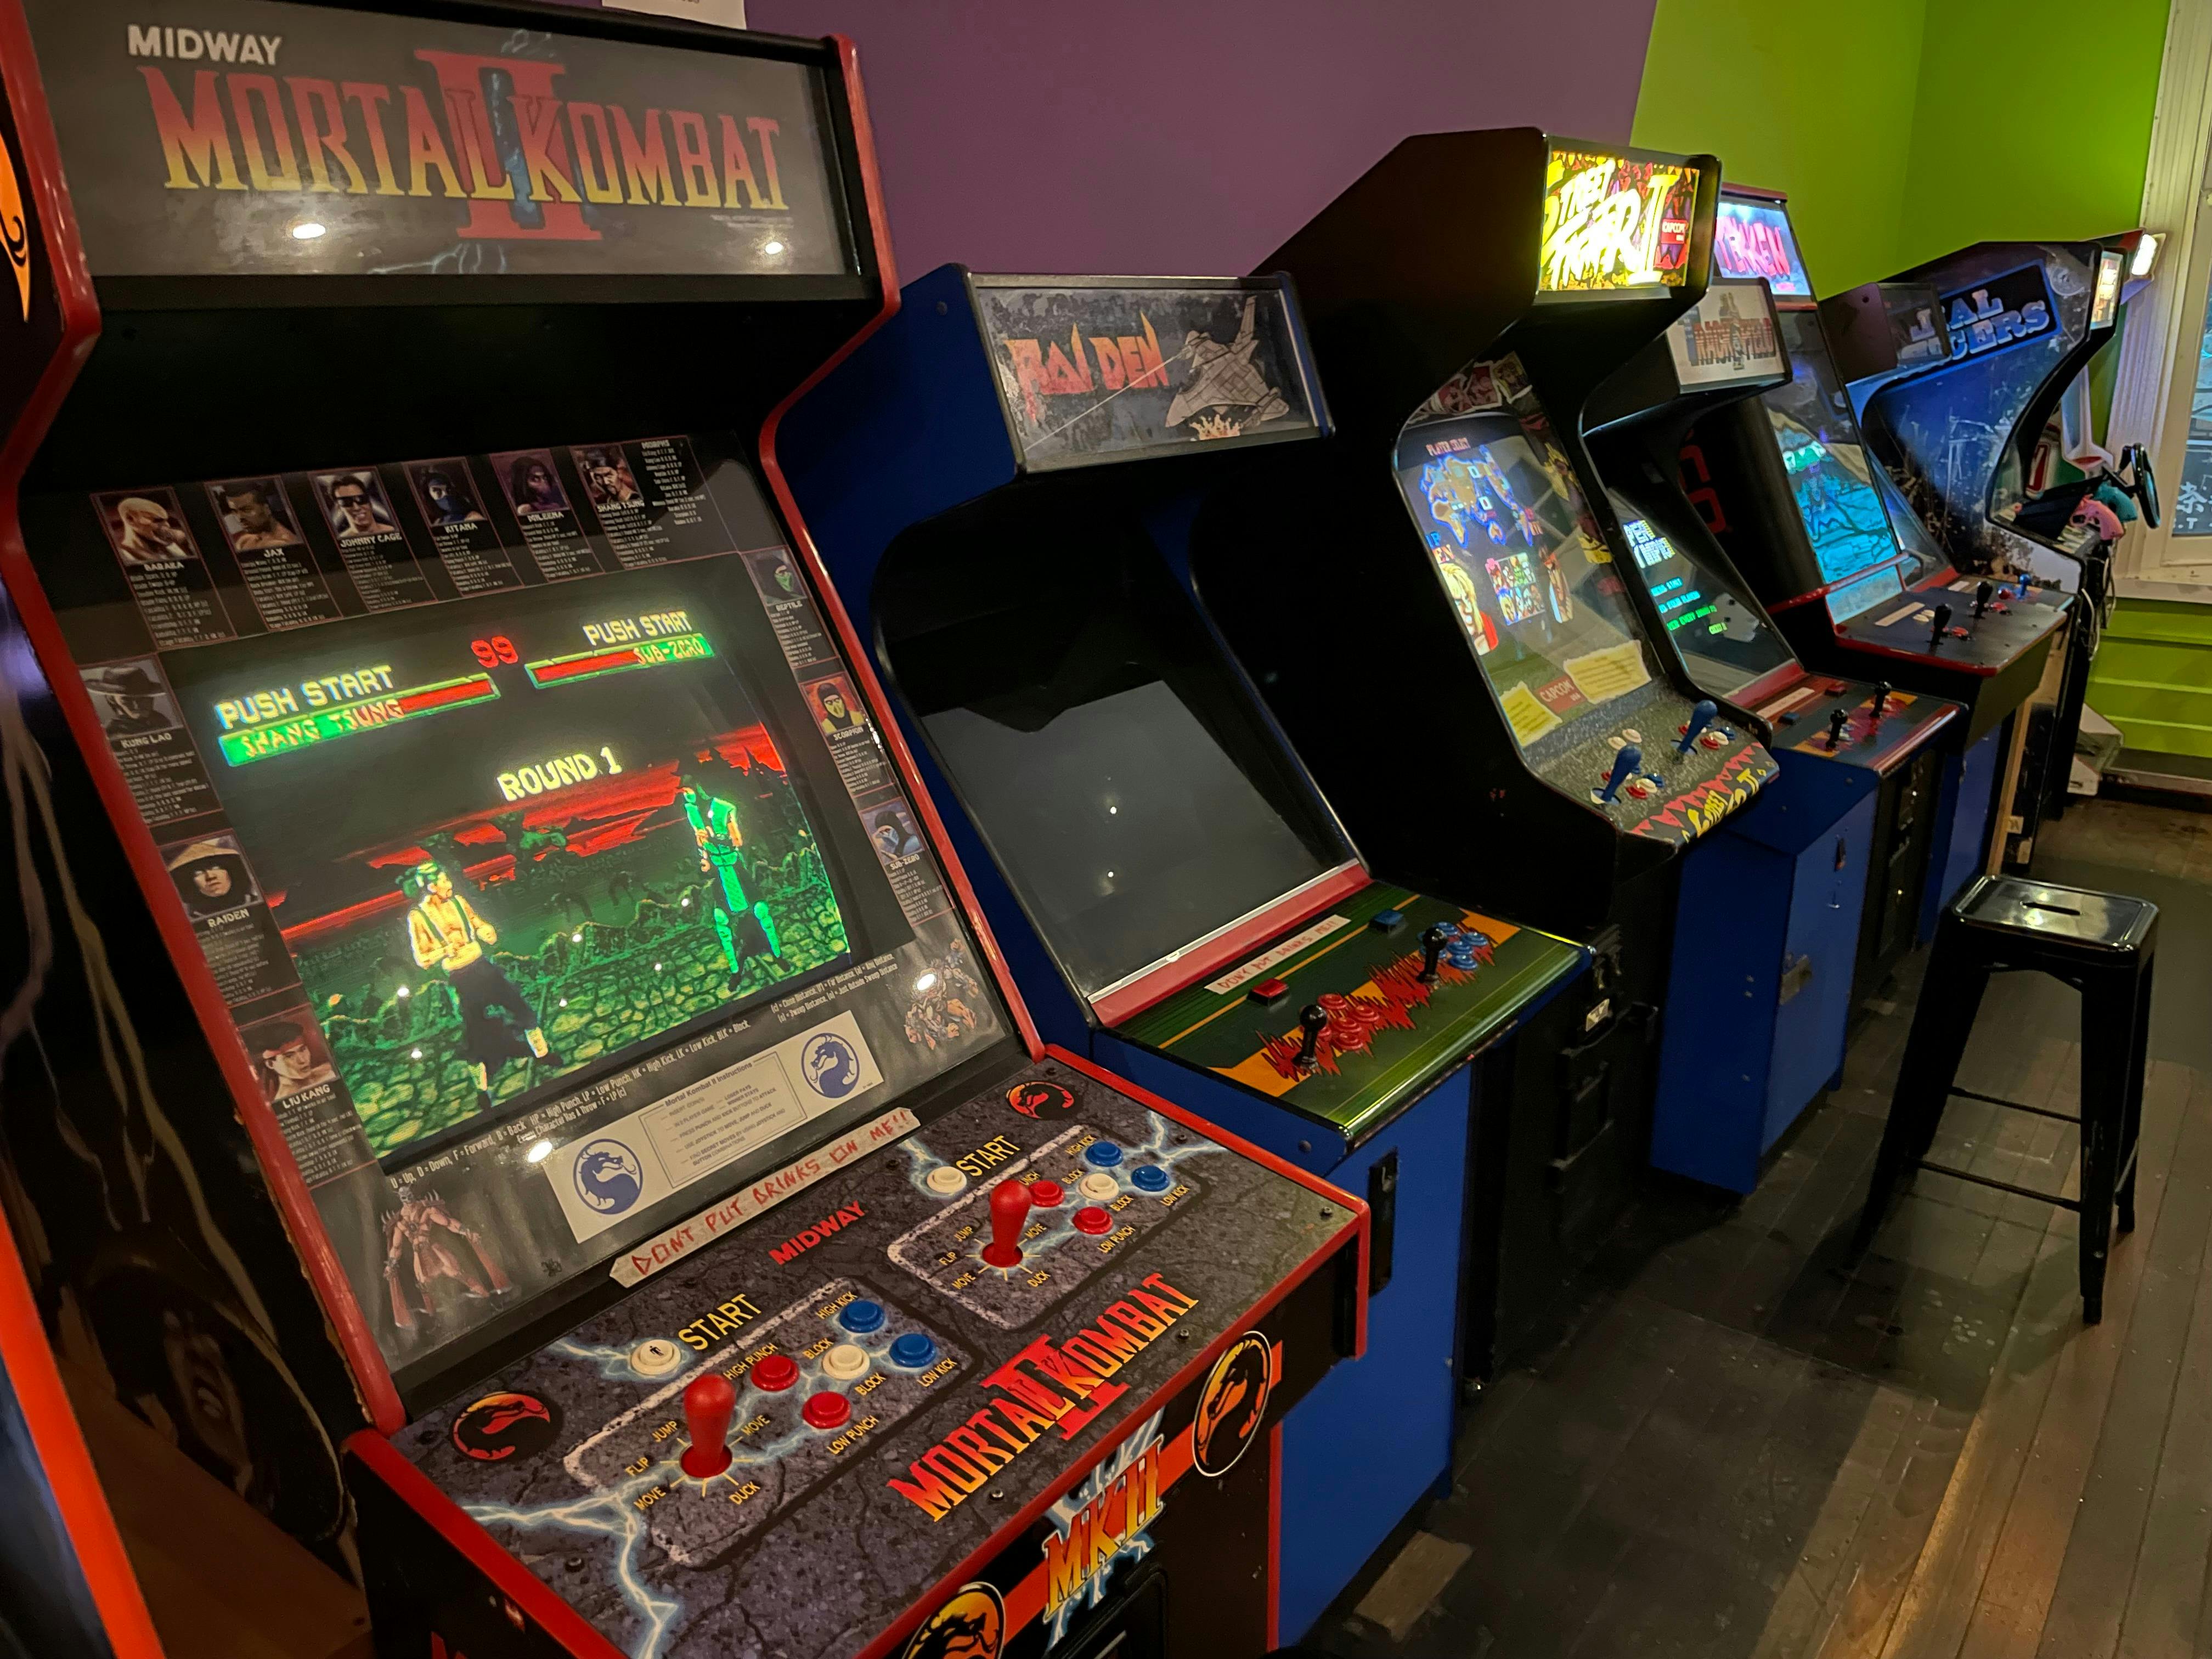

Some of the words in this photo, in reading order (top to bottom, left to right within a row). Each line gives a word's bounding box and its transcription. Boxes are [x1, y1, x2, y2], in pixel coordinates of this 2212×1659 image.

[127, 25, 282, 65] MIDWAY
[137, 65, 515, 199] MORTAL
[506, 95, 789, 211] KOMBAT
[1003, 311, 1170, 426] RAIDEN
[527, 511, 564, 522] MILEENA
[596, 502, 622, 513] SHANG
[340, 535, 376, 548] JOHNNY
[377, 532, 403, 544] CAGE
[444, 522, 478, 533] KITANA
[263, 548, 285, 558] JAX
[583, 618, 641, 646] PUSH
[640, 611, 693, 637] START
[470, 635, 520, 668] 99
[214, 687, 300, 730] PUSH
[301, 665, 395, 708] START
[1539, 679, 1572, 702] CAPCOM
[120, 736, 149, 749] KUNG
[149, 731, 173, 744] LAO
[240, 714, 321, 758] SHANG
[329, 698, 404, 738] TSUNG
[833, 726, 864, 741] SCORPION
[496, 752, 596, 802] ROUND
[600, 747, 623, 774] 1
[890, 854, 920, 871] SUB-ZERO
[207, 909, 250, 928] RAIDEN
[1251, 956, 1273, 970] PUT
[789, 1005, 806, 1018] Sweep
[848, 978, 865, 990] Outside
[864, 970, 880, 983] Sweep
[879, 963, 898, 975] Distance
[282, 1094, 301, 1109] LIU
[301, 1084, 331, 1102] KANG
[665, 1093, 686, 1106] Mortal
[686, 1080, 712, 1096] Kombat
[716, 1062, 752, 1082] Instructions
[416, 1166, 424, 1176] D
[453, 1150, 460, 1159] F
[496, 1130, 504, 1140] B
[507, 1120, 526, 1135] Back
[529, 1114, 540, 1125] HP
[545, 1103, 562, 1119] High
[582, 1090, 590, 1101] LP
[595, 1082, 610, 1094] Low
[631, 1068, 641, 1078] HK
[646, 1059, 662, 1073] High
[676, 1048, 684, 1059] LK
[689, 1040, 702, 1052] Low
[716, 1029, 729, 1040] BLK
[563, 1110, 576, 1121] Has
[575, 1107, 581, 1116] A
[580, 1099, 597, 1114] Throw
[609, 1091, 618, 1101] LP
[956, 1135, 1020, 1177] START
[1065, 1141, 1083, 1155] HIGH
[1080, 1134, 1097, 1147] KICK
[706, 1200, 744, 1233] PUT
[752, 1159, 822, 1206] DRINKS
[830, 1139, 859, 1164] ON
[870, 1111, 906, 1142] ME!!
[1019, 1171, 1040, 1187] UNCH
[1061, 1168, 1084, 1184] BLOCK
[1110, 1194, 1133, 1212] BLOCK
[1159, 1193, 1175, 1207] LOW
[1172, 1184, 1190, 1200] KICK
[769, 1200, 867, 1265] MIDWAY
[954, 1226, 974, 1243] JUMP
[1024, 1223, 1047, 1239] MOVE
[1097, 1240, 1114, 1255] LOW
[1111, 1225, 1136, 1244] PUNCH
[939, 1251, 957, 1266] FLIP
[952, 1272, 977, 1291] MOVE
[1026, 1271, 1051, 1289] DUCK
[817, 1299, 839, 1320] HIGH
[837, 1290, 859, 1307] KICK
[678, 1293, 763, 1351] START
[724, 1359, 747, 1380] HIGH
[746, 1342, 779, 1366] PUNCH
[803, 1337, 834, 1361] BLOCK
[855, 1372, 887, 1397] BLOCK
[917, 1368, 938, 1388] LOW
[934, 1357, 958, 1376] KICK
[886, 1376, 1073, 1522] MORTAL
[1035, 1273, 1199, 1400] KOMBAT
[653, 1419, 679, 1444] JUMP
[741, 1414, 771, 1437] MOVE
[827, 1435, 849, 1455] LOW
[845, 1414, 880, 1441] PUNCH
[625, 1456, 650, 1479] FLIP
[634, 1484, 667, 1511] MOVE
[729, 1481, 761, 1506] DUCK
